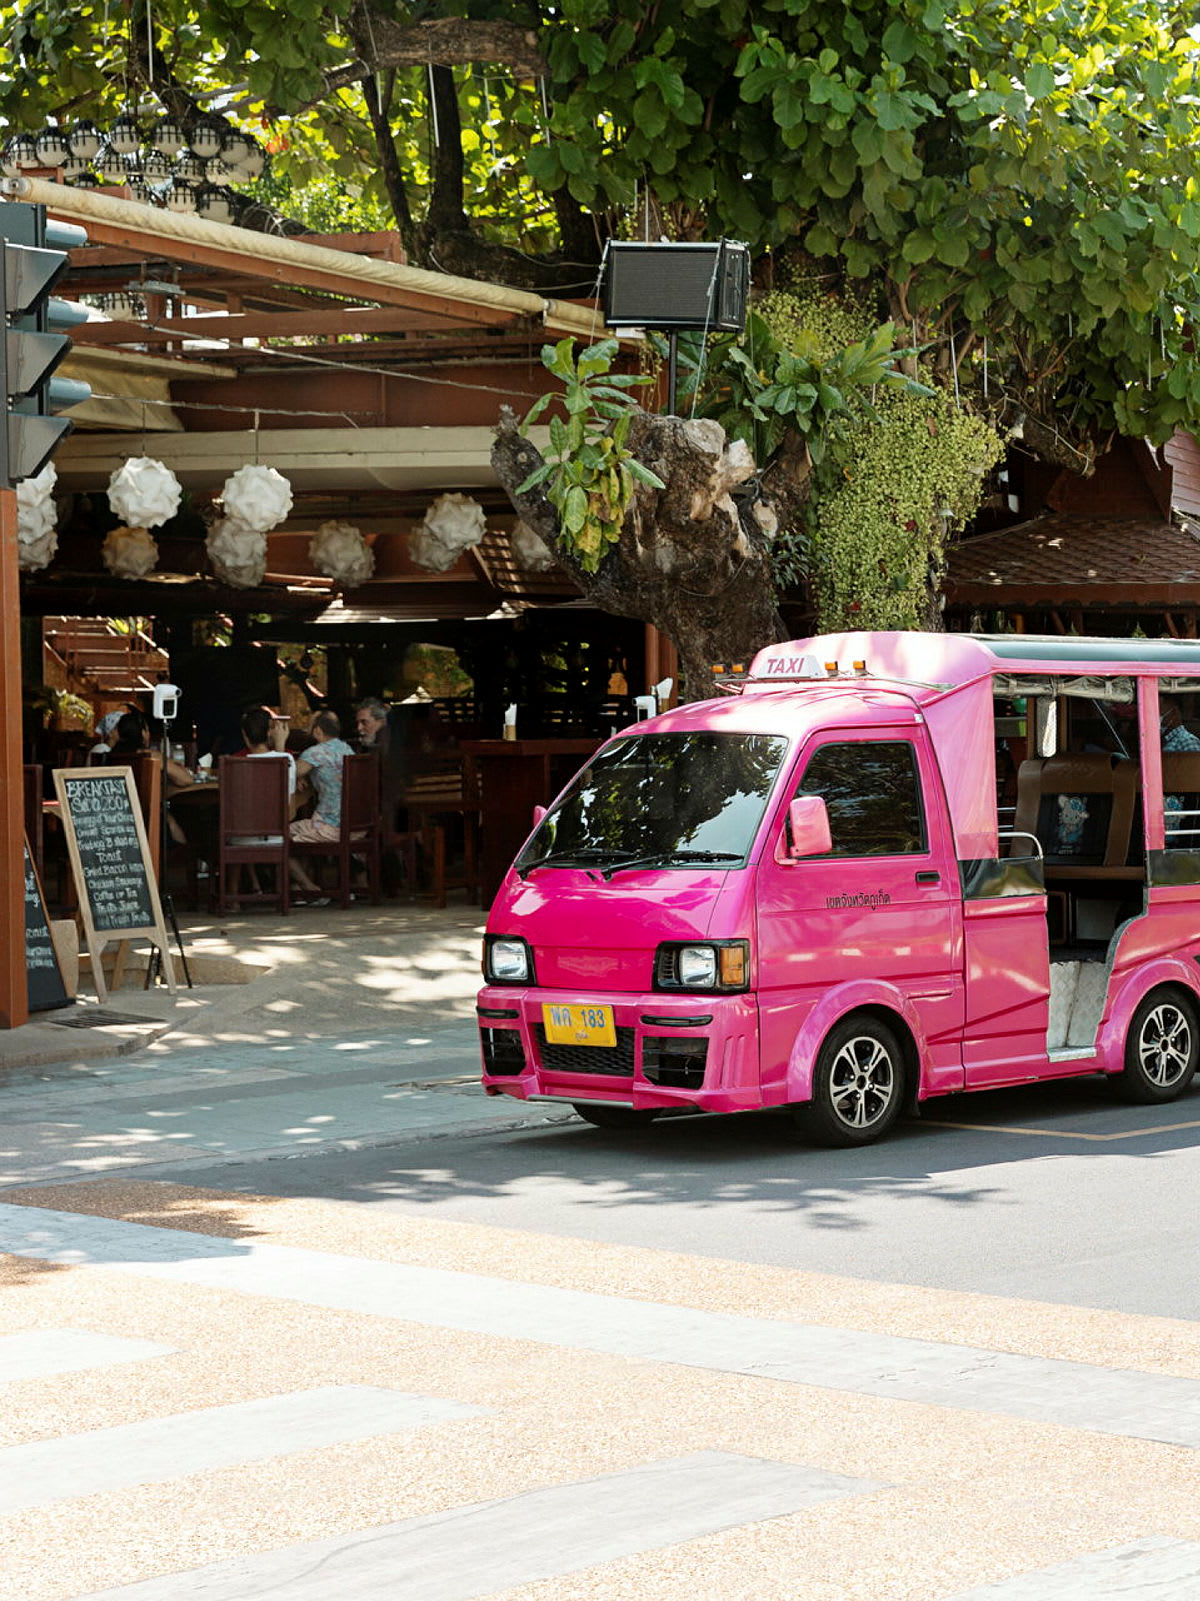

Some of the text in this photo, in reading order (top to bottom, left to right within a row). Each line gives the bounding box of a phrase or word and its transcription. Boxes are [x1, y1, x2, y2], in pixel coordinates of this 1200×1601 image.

[767, 657, 805, 674] TAXI
[66, 780, 127, 798] BREAKFAST
[581, 1009, 606, 1028] 183
